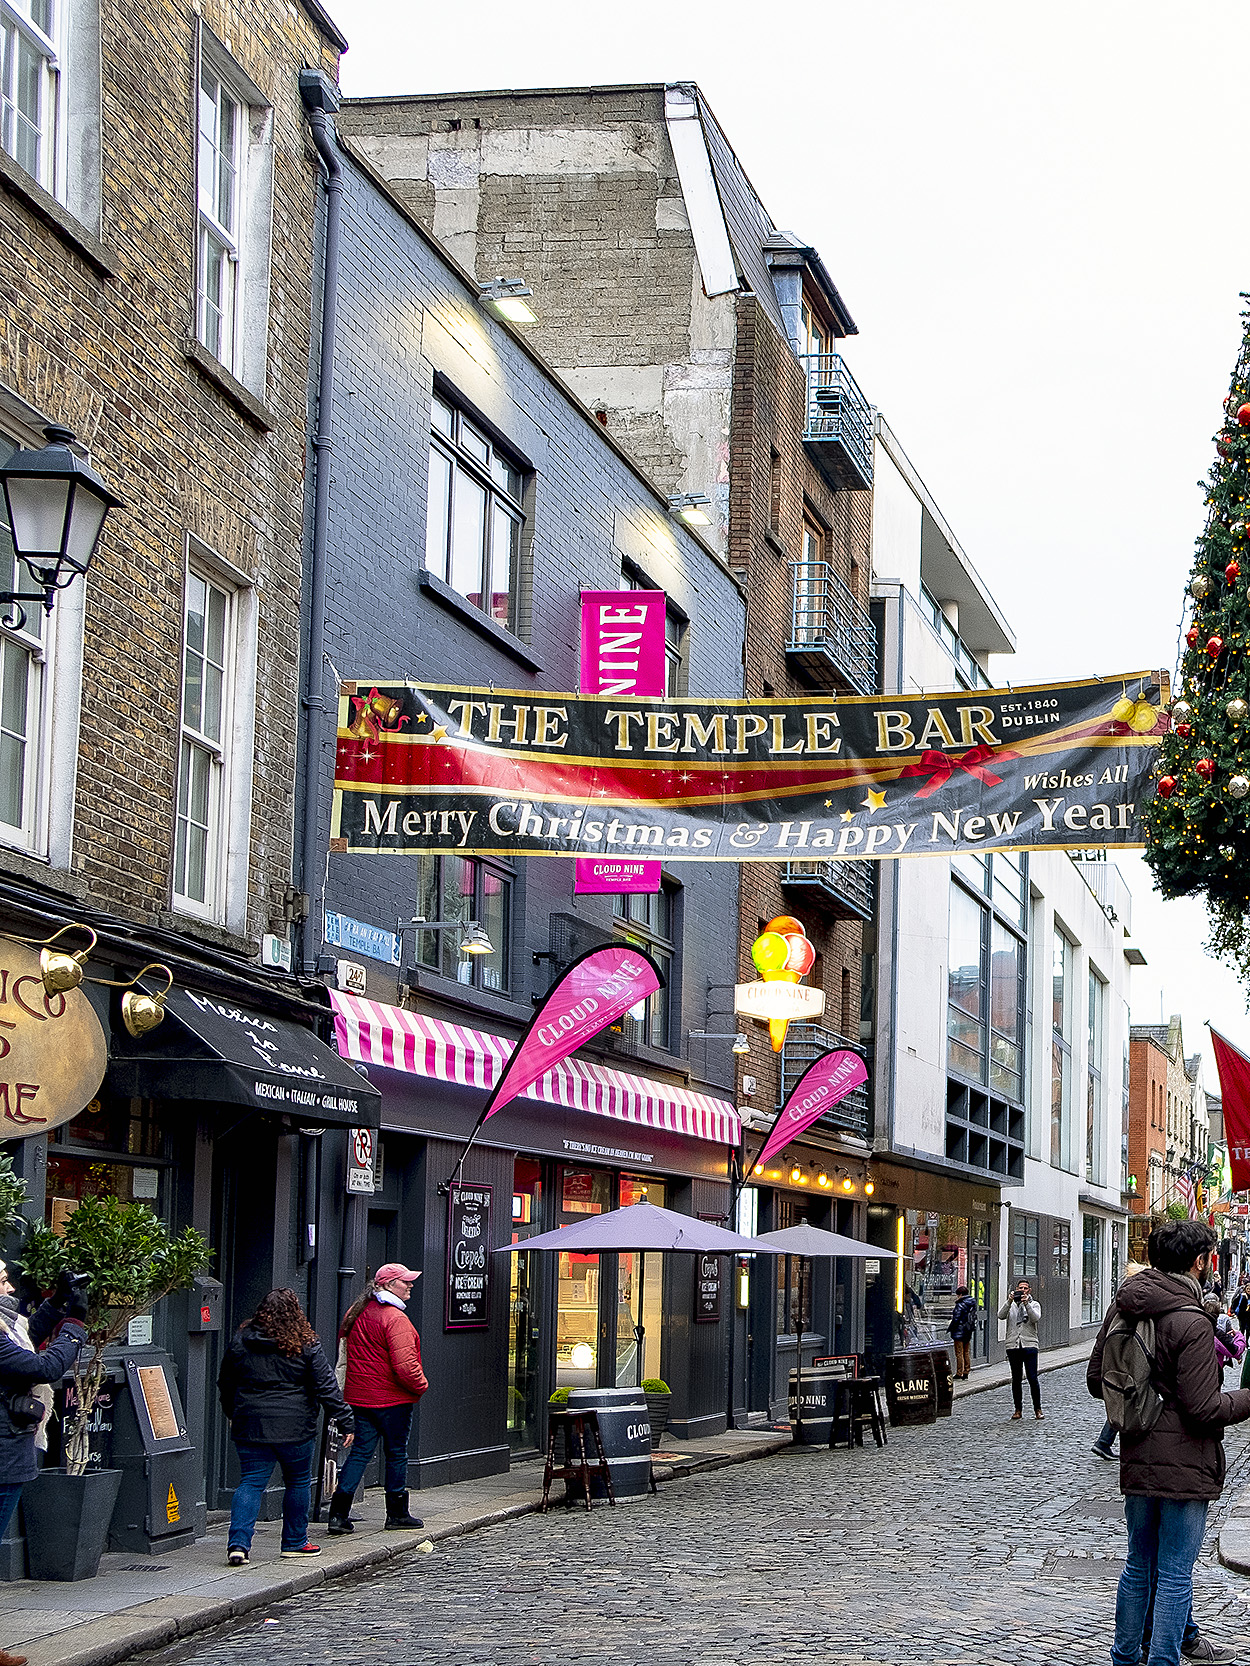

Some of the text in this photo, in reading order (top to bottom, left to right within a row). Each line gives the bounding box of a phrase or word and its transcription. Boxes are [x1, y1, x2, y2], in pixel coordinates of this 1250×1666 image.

[599, 605, 648, 696] NINE
[447, 699, 1002, 755] THE TEMPLE BAR
[1002, 712, 1061, 728] DUBLIN
[1024, 765, 1129, 791] Wishes All
[361, 797, 1134, 856] Merry Christmas & Happy New Year
[594, 865, 645, 875] CLOUD NINE
[349, 935, 370, 952] TEMPLE
[537, 959, 644, 1047] CLOUD NINE
[748, 986, 810, 1002] CLOUD NINE
[255, 1082, 359, 1113] MEXICAN ITALIAN GRILL HOUSE
[788, 1085, 829, 1121] CLOUD
[828, 1057, 859, 1087] NINE
[895, 1380, 929, 1393] SLANE
[806, 1395, 827, 1407] NINE
